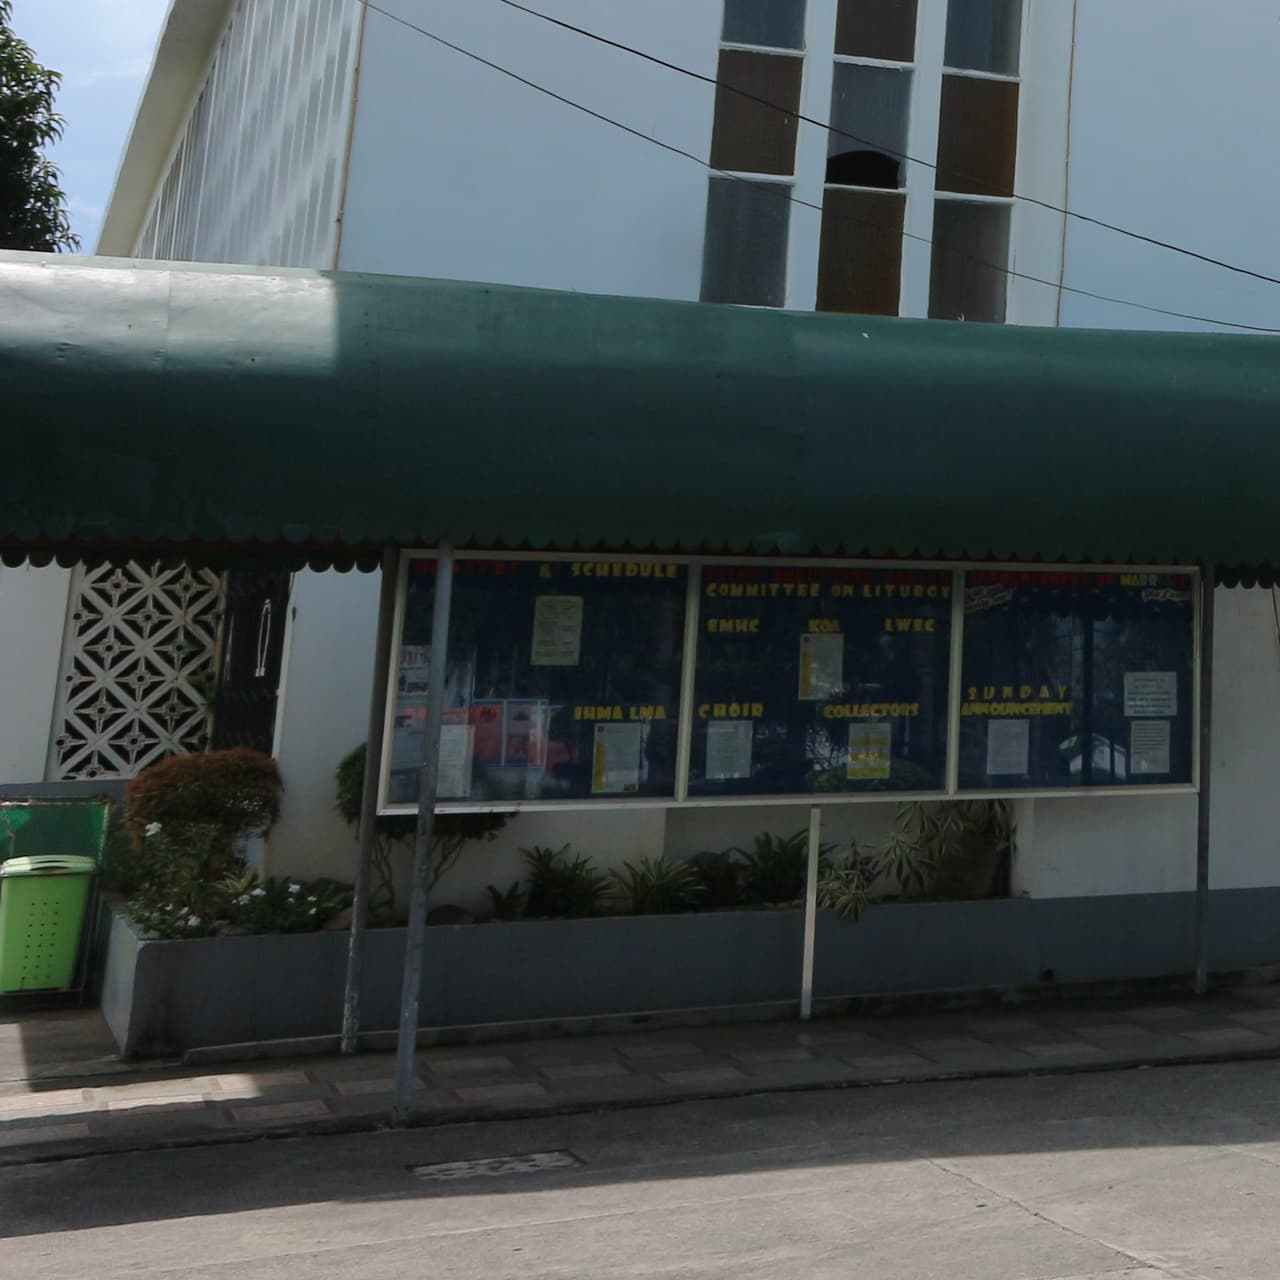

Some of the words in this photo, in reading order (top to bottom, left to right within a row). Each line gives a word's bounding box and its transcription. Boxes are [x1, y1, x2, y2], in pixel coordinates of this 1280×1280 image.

[571, 561, 678, 578] SCHEDULE
[704, 582, 821, 598] COMMITTEE
[831, 584, 854, 599] ON
[863, 584, 950, 599] LITURGY
[967, 683, 1069, 700] SUNDAY
[698, 702, 764, 719] CHOIR
[823, 702, 920, 719] COLLECTORS
